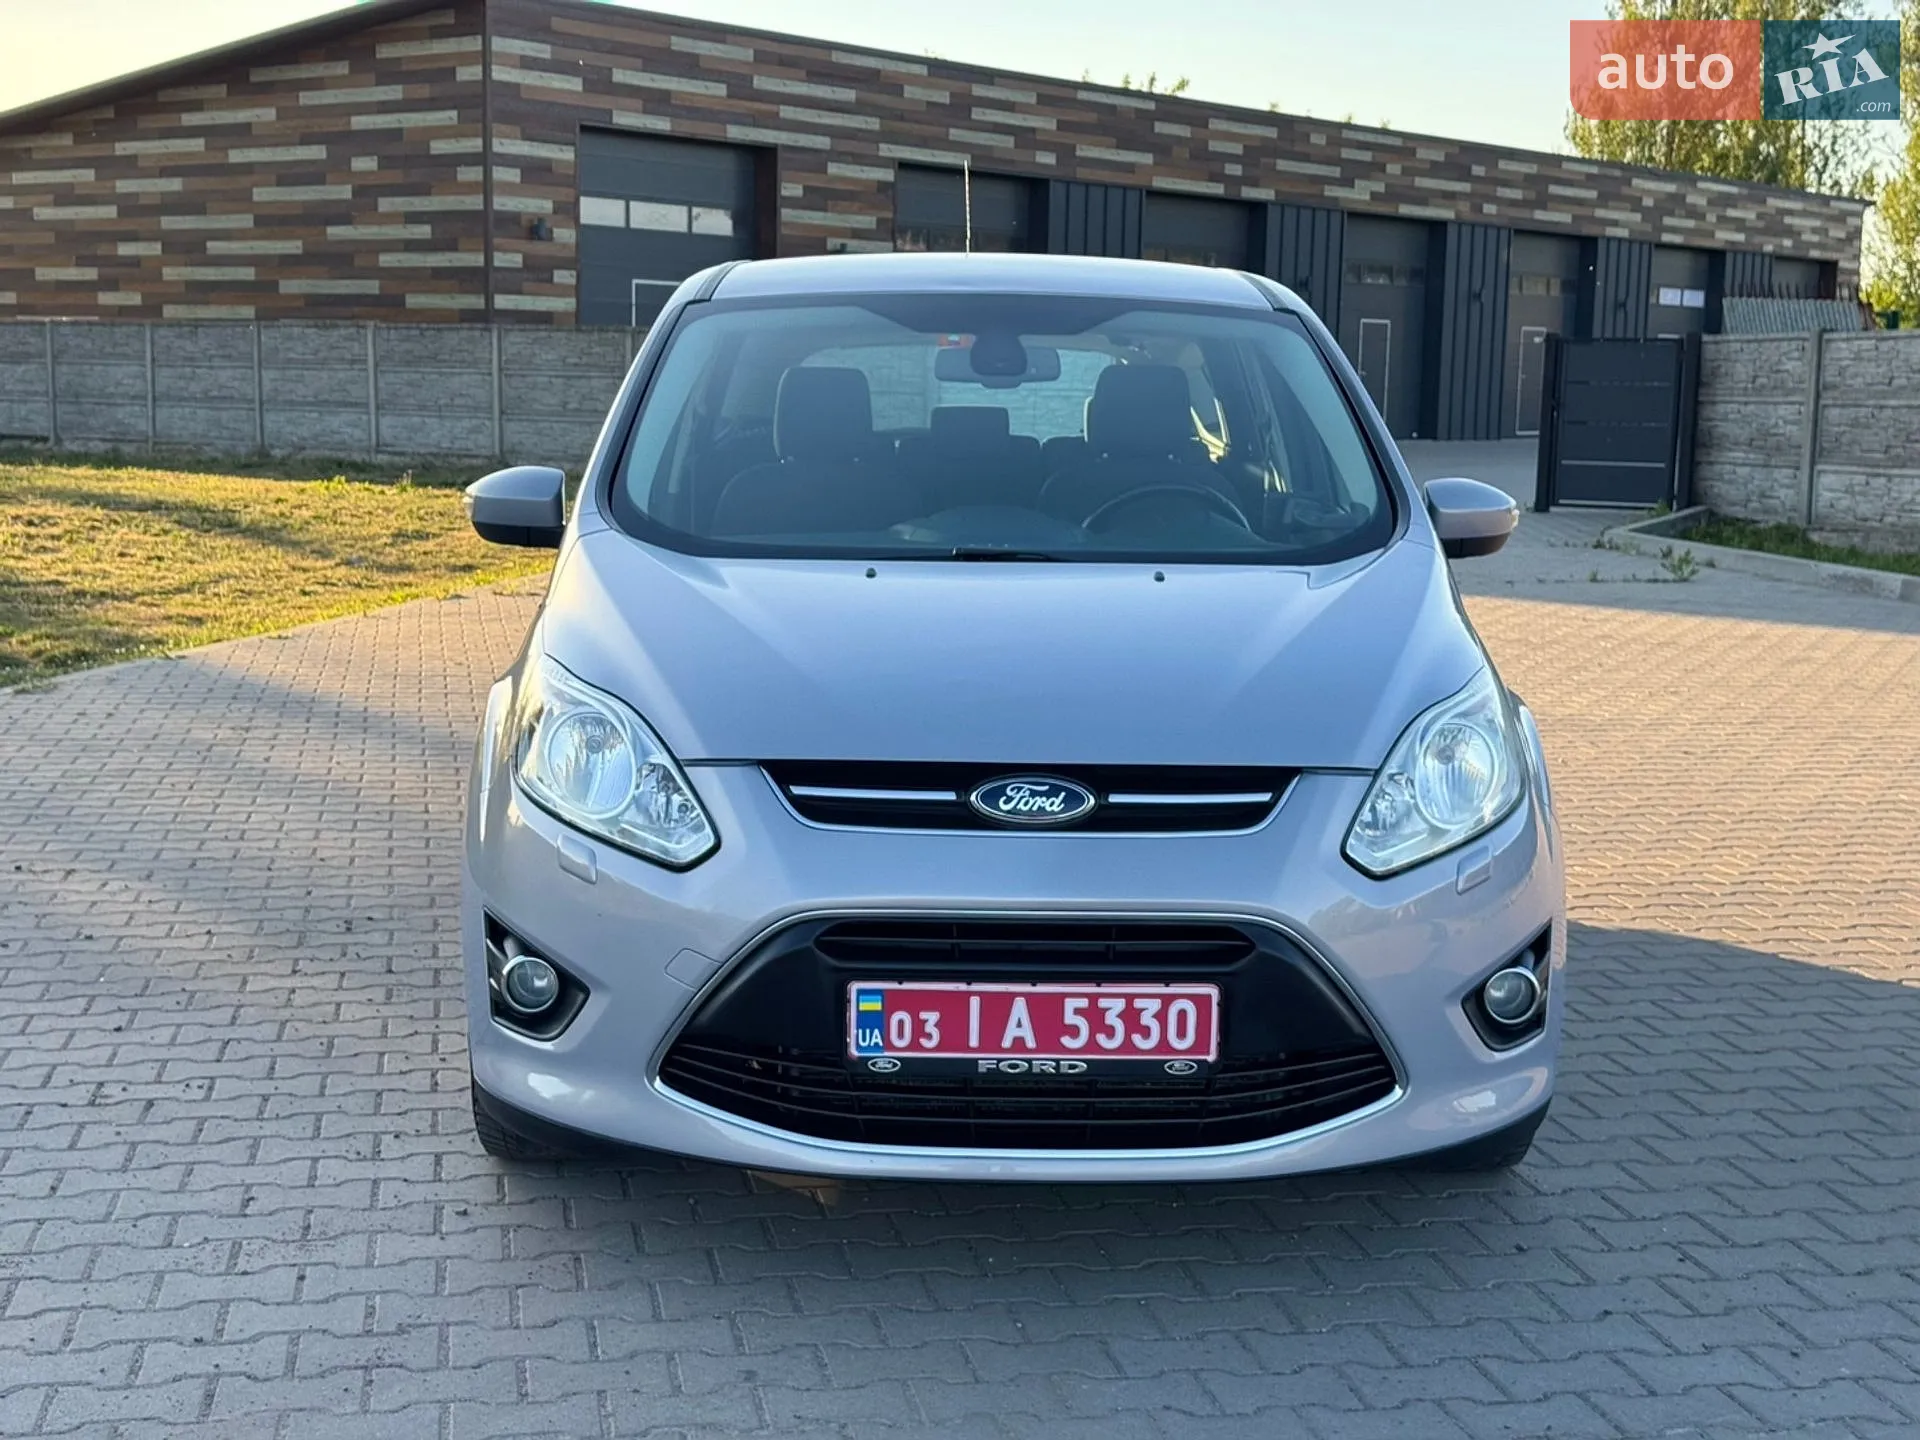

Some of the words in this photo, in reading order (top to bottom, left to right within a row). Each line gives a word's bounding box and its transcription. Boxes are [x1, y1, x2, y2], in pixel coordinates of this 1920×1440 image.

[999, 783, 1066, 812] Ford
[890, 1011, 940, 1049] 03
[1059, 997, 1197, 1050] 5330
[858, 1028, 883, 1047] UA
[977, 1060, 1088, 1074] FORD
